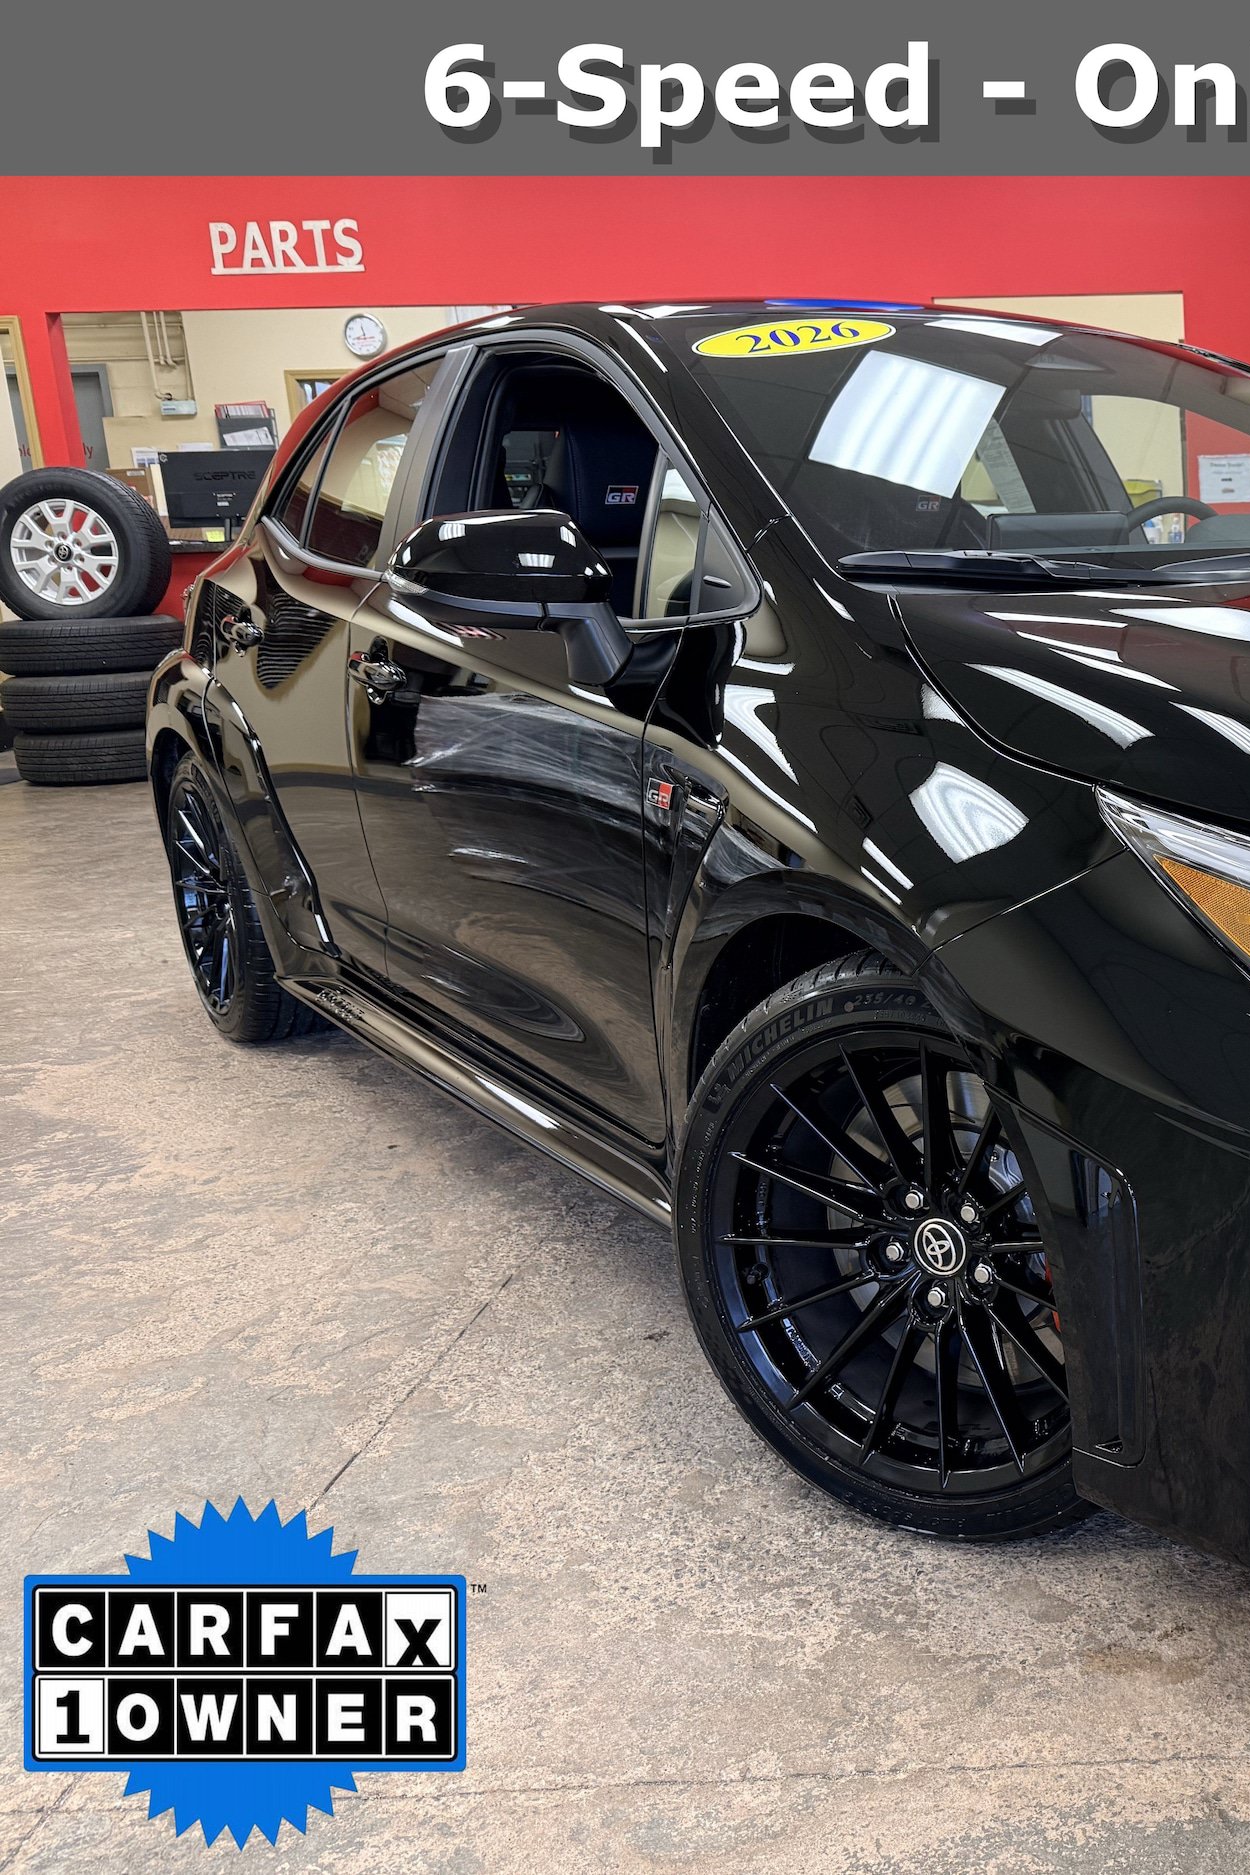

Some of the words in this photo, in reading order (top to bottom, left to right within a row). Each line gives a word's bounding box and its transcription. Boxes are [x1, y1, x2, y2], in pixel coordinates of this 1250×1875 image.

[208, 218, 364, 270] PARTS
[735, 321, 860, 354] 2026
[193, 470, 257, 480] SCEPTRE
[607, 492, 635, 503] GR
[917, 500, 940, 510] GR
[648, 788, 670, 807] GR
[727, 998, 835, 1083] MICHELIN
